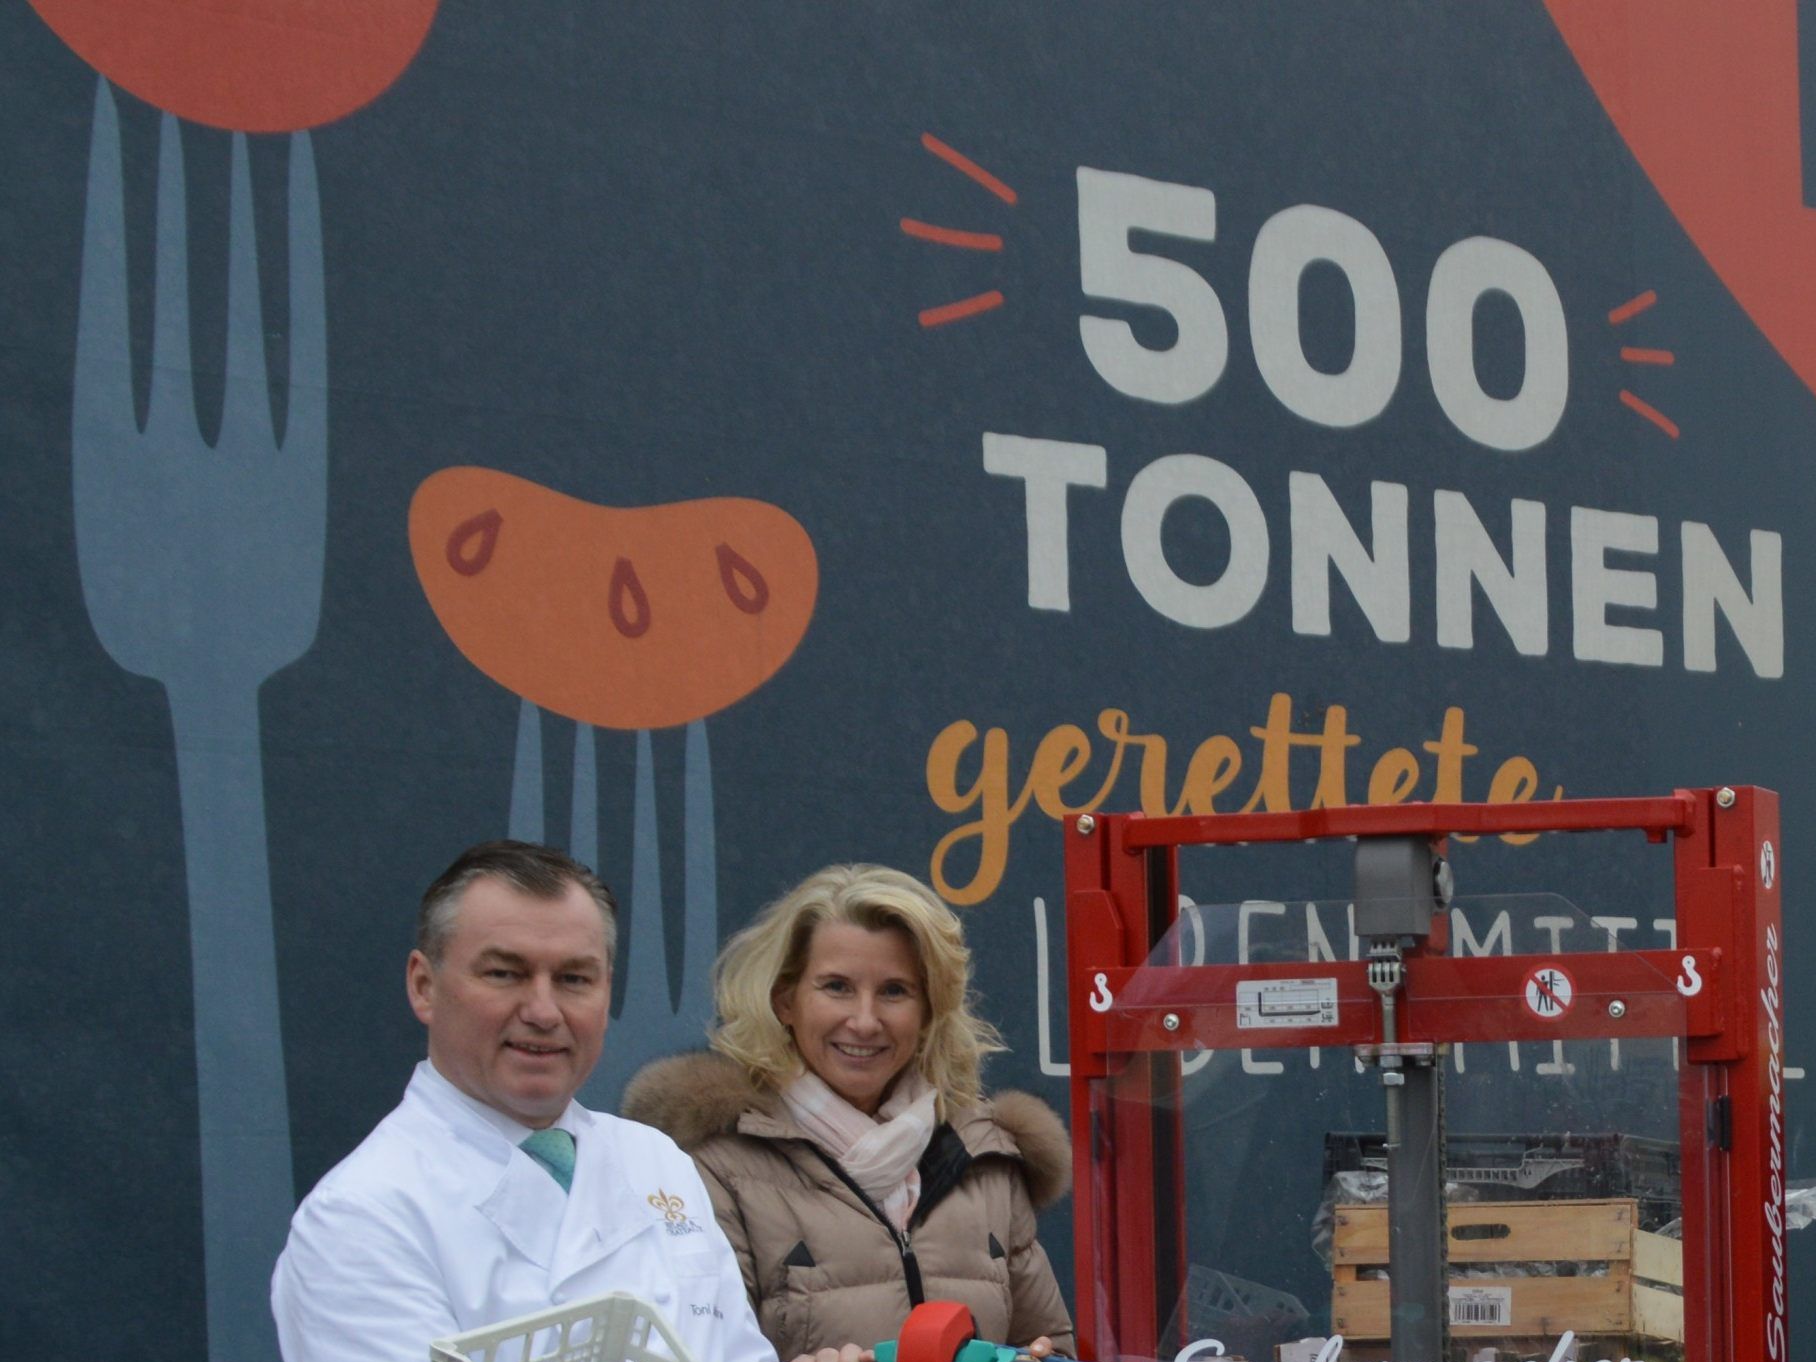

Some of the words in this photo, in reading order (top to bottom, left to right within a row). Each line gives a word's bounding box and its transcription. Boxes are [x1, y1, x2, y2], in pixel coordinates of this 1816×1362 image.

[1075, 164, 1569, 451] 500
[981, 430, 1784, 679] TONNEN
[926, 692, 1565, 906] gerettete
